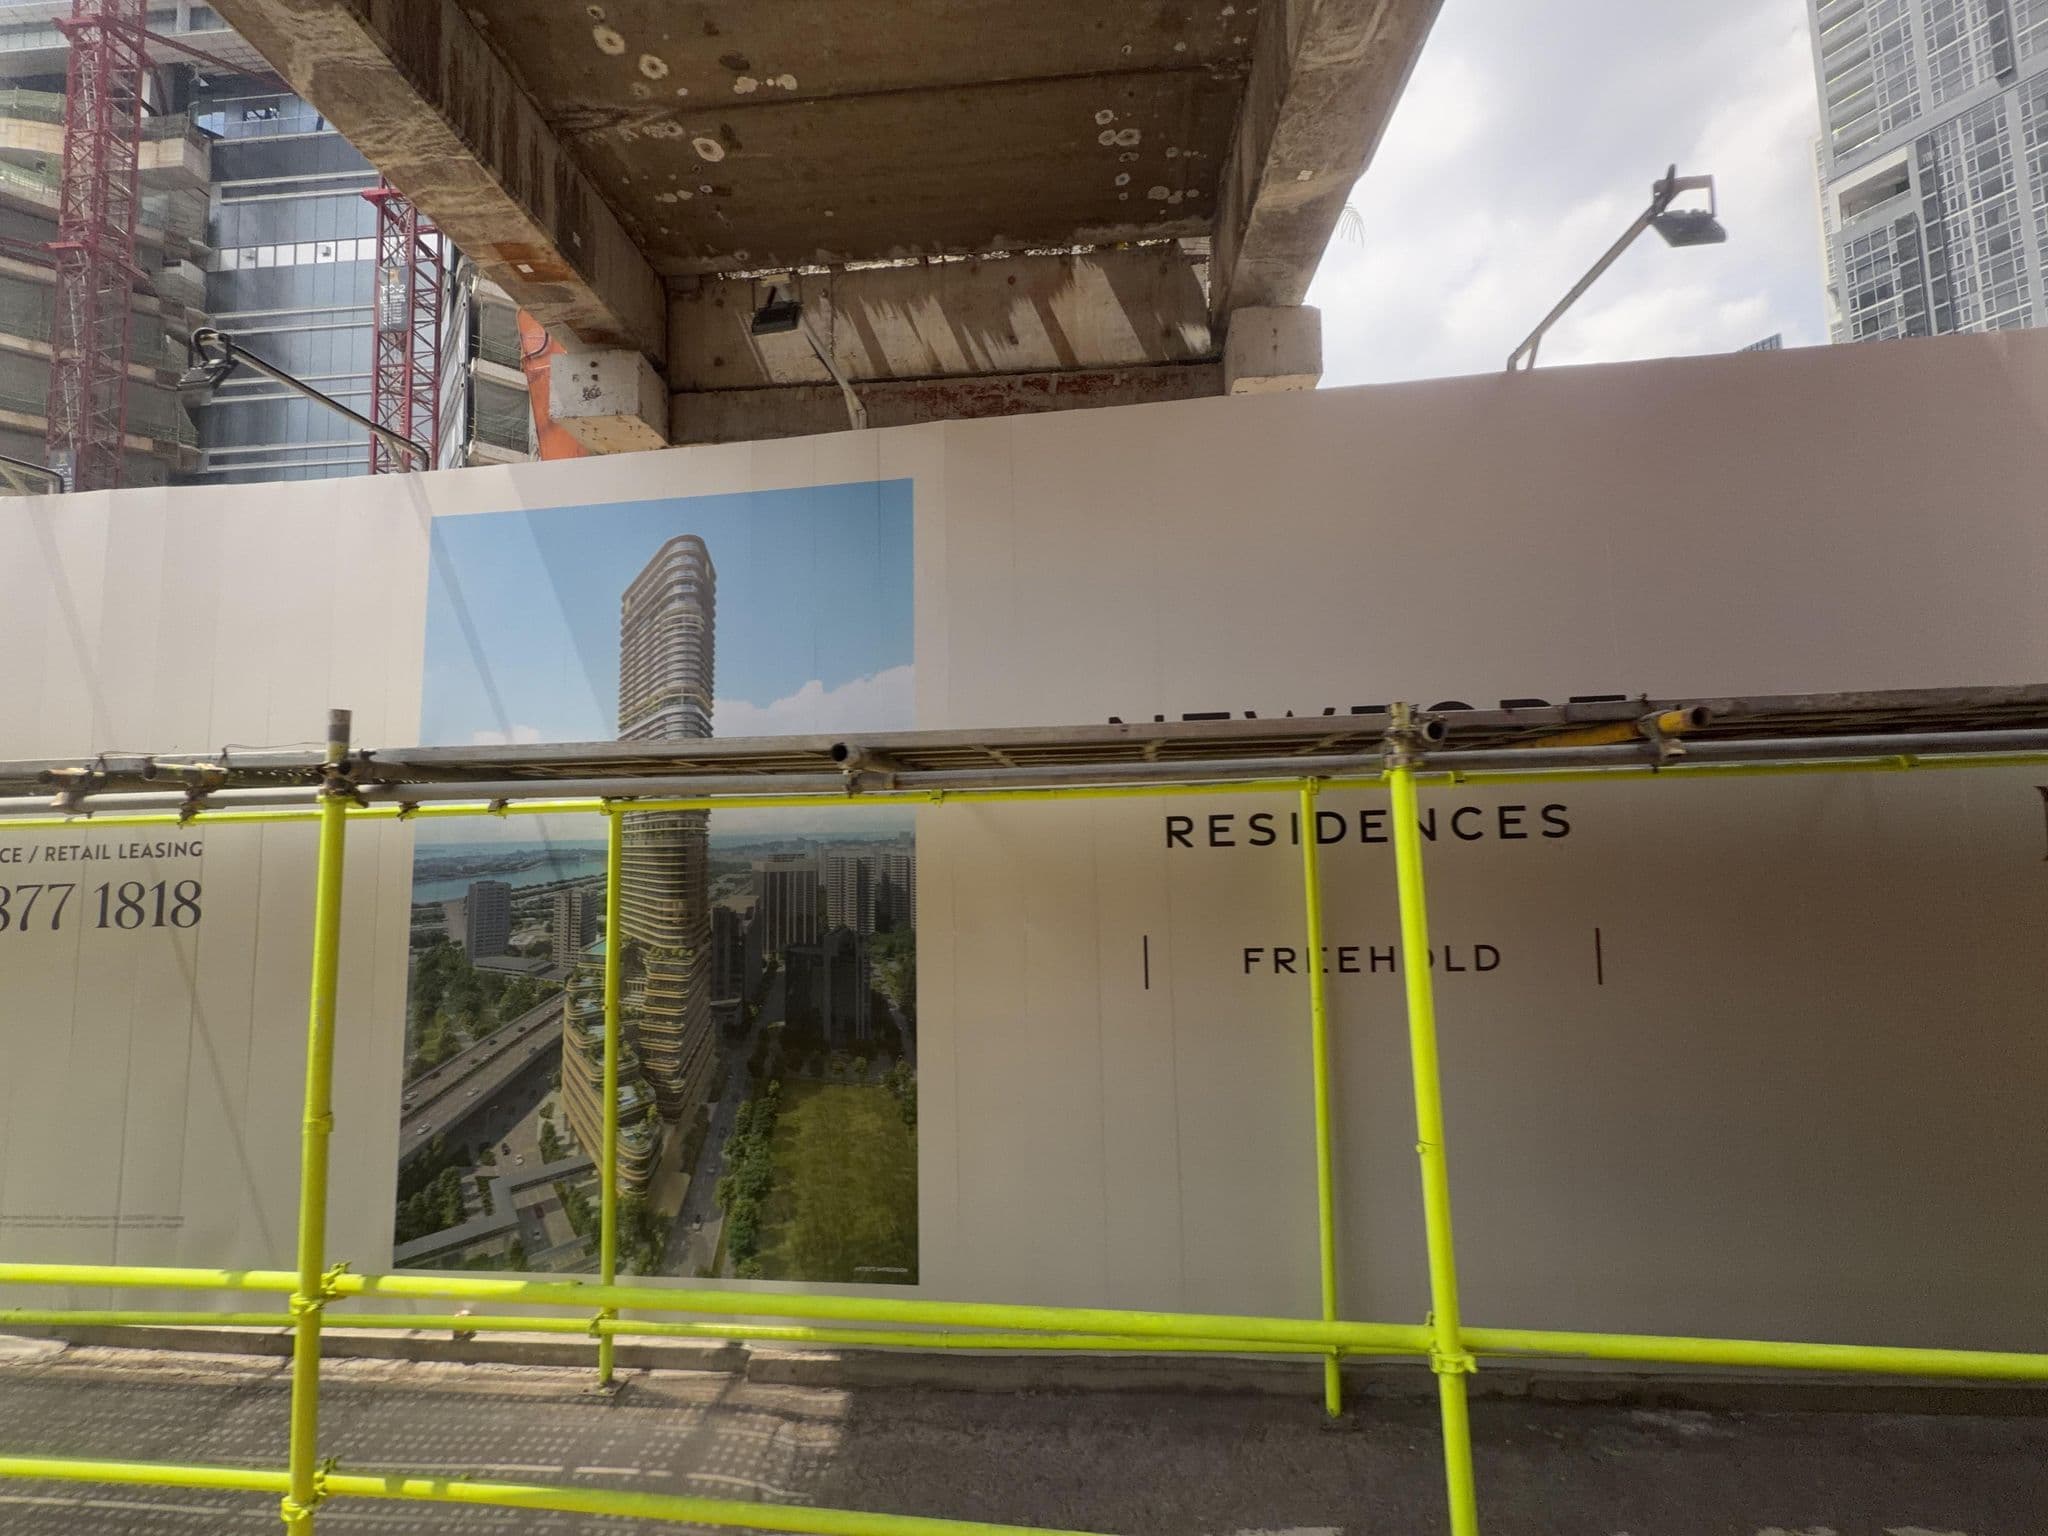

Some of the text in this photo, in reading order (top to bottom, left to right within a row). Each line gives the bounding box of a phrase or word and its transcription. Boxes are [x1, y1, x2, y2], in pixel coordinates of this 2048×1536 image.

[44, 843, 111, 862] RETAIL
[119, 841, 203, 859] LEASING
[94, 879, 202, 930] 1818
